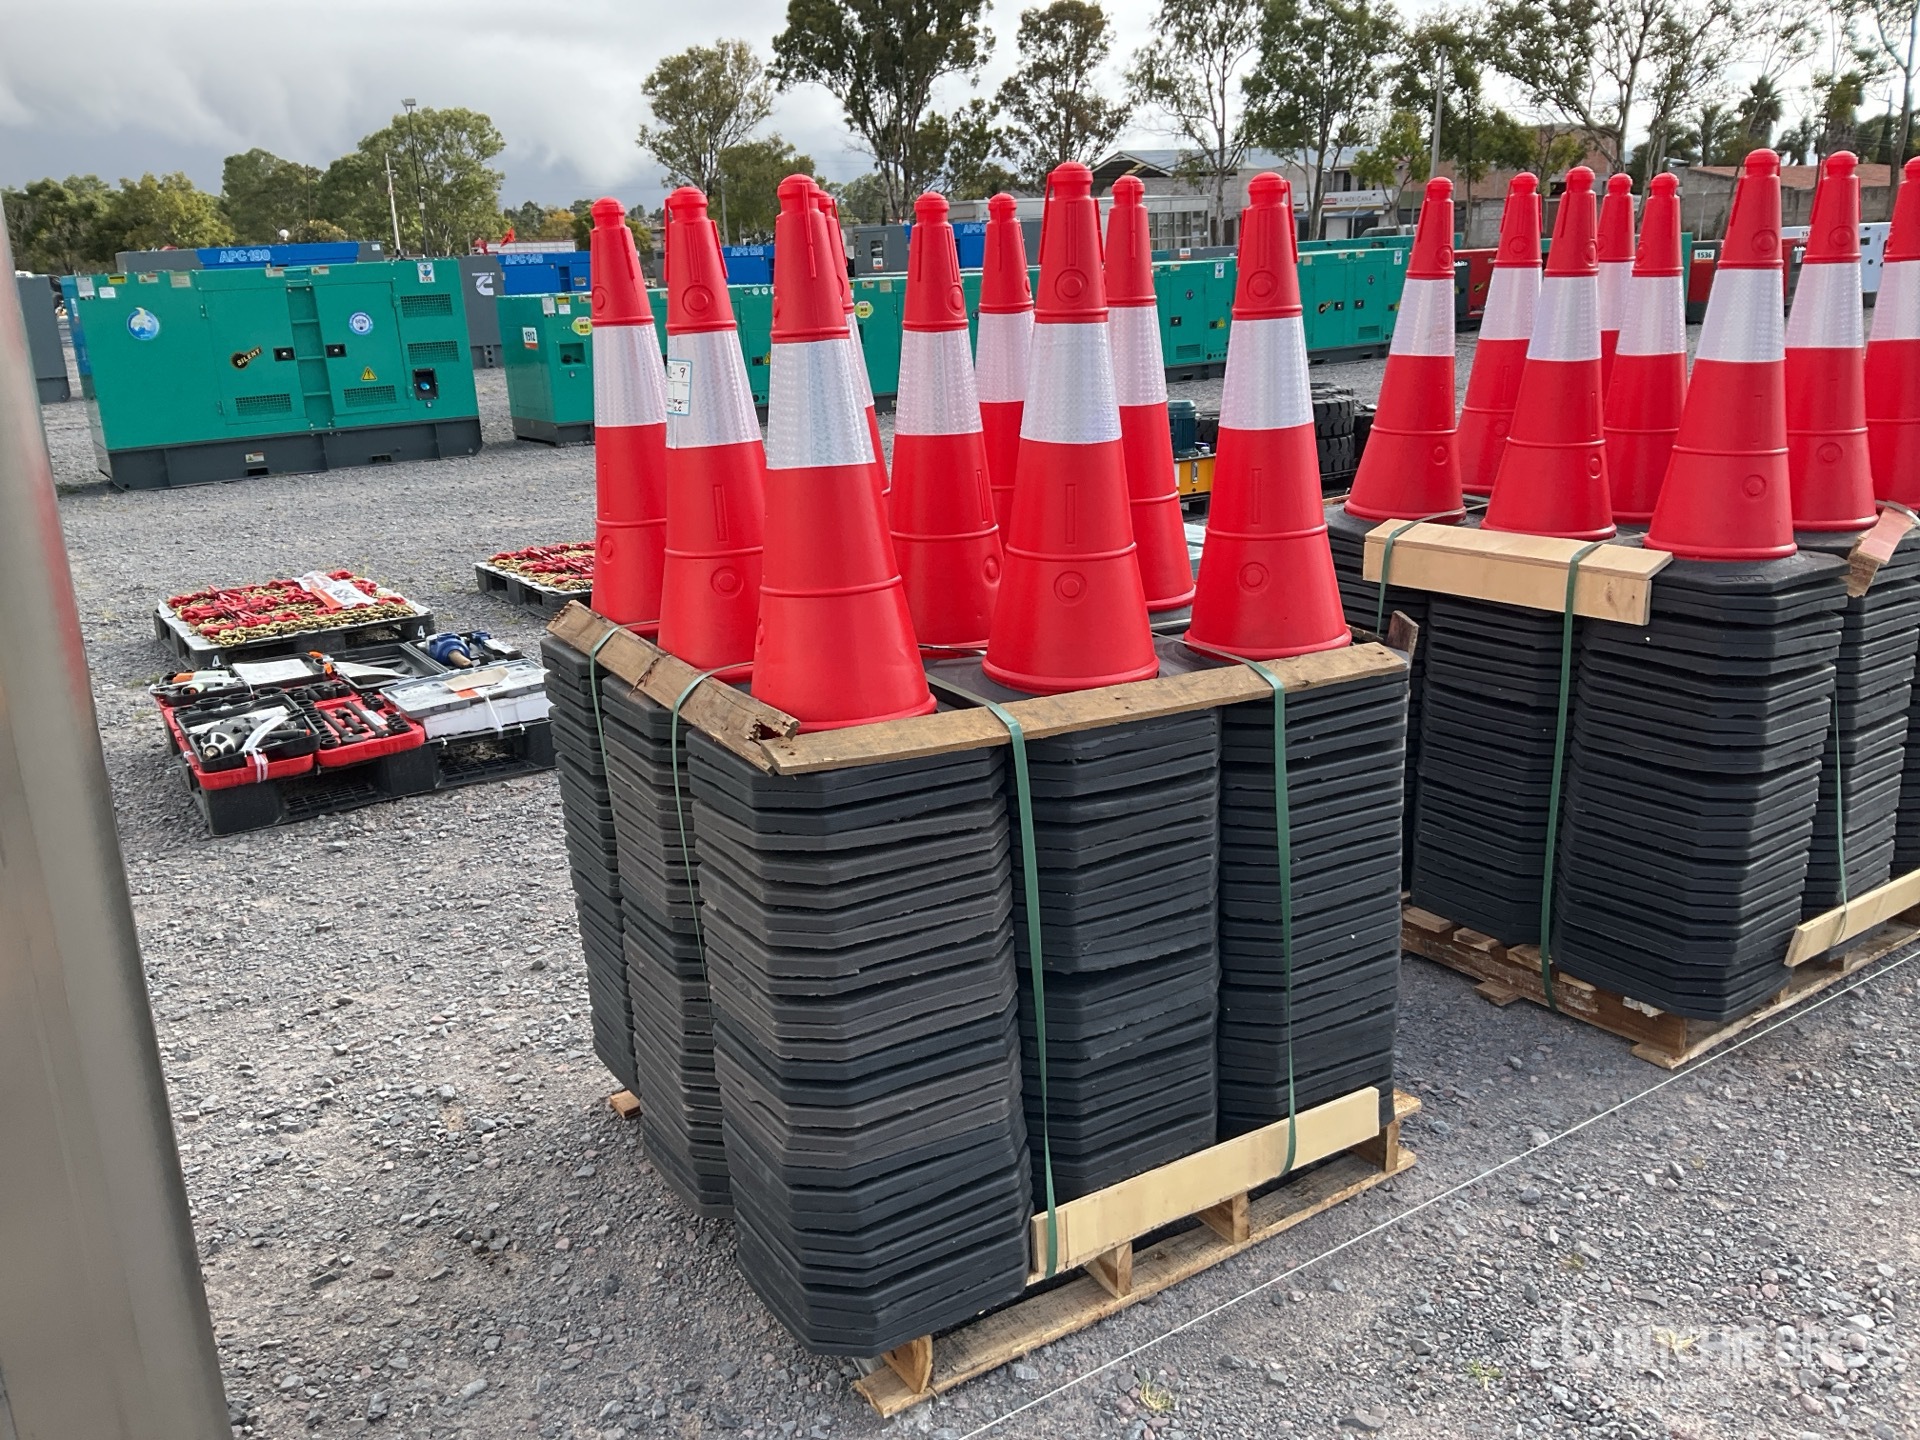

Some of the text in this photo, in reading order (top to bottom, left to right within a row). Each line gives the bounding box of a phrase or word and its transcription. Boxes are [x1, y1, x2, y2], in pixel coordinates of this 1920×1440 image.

[1697, 250, 1713, 259] 1536
[236, 348, 260, 367] SILENT
[417, 625, 426, 639] 4
[211, 654, 221, 668] 4
